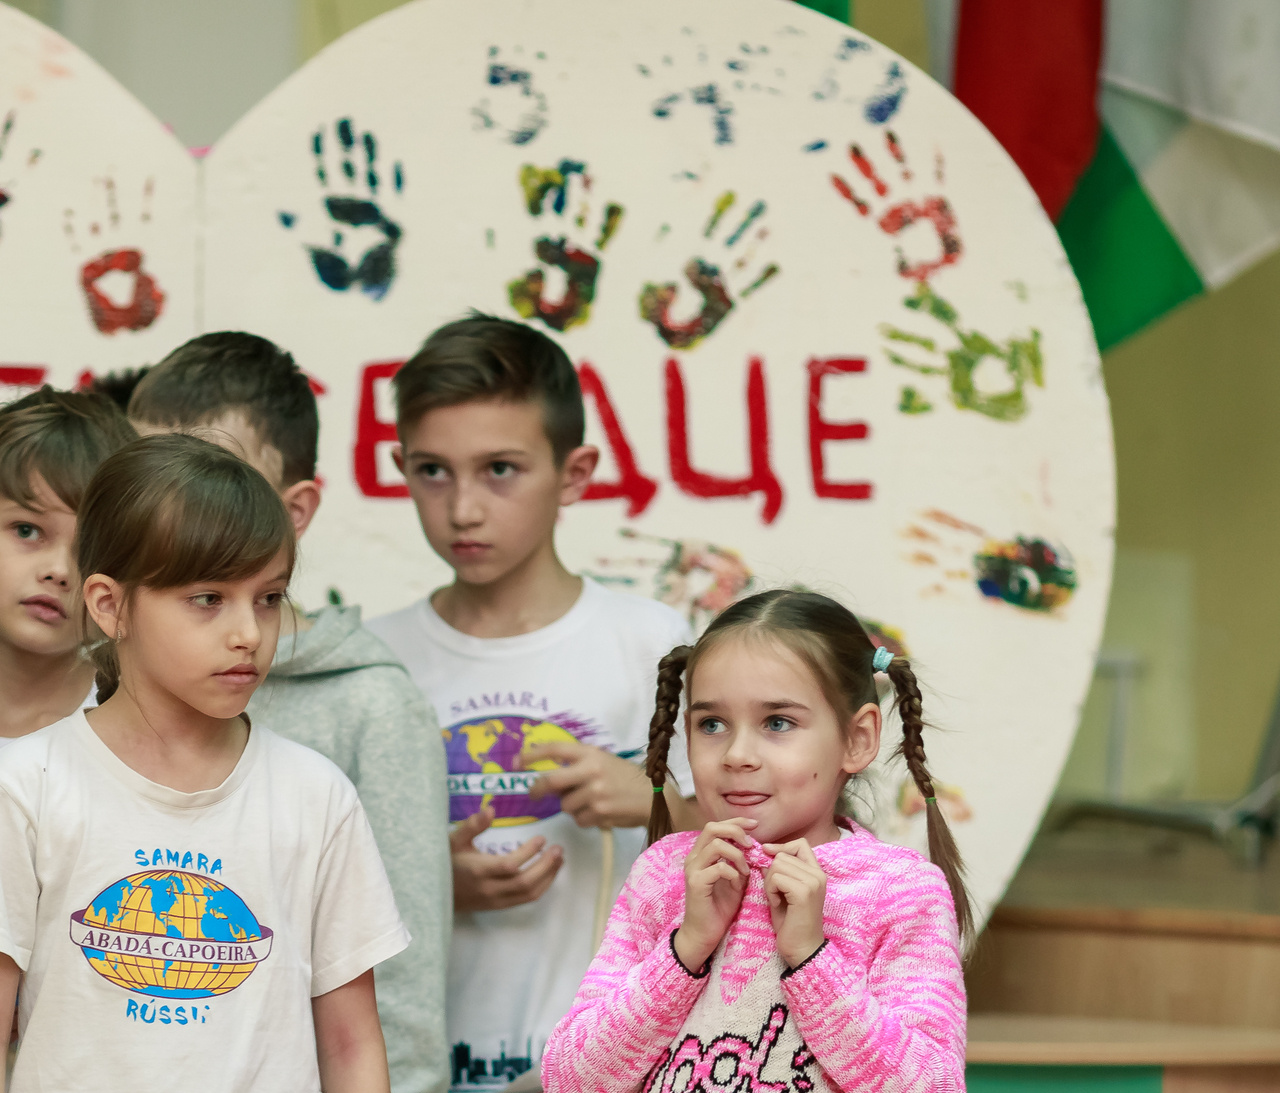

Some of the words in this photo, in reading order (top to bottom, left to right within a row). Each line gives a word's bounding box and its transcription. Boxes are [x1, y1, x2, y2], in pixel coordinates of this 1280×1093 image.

[450, 690, 550, 714] SAMARA
[134, 848, 223, 876] SAMARA
[80, 929, 258, 962] ABADÁ-CAPOEIRA
[126, 998, 211, 1026] RÚSSI
